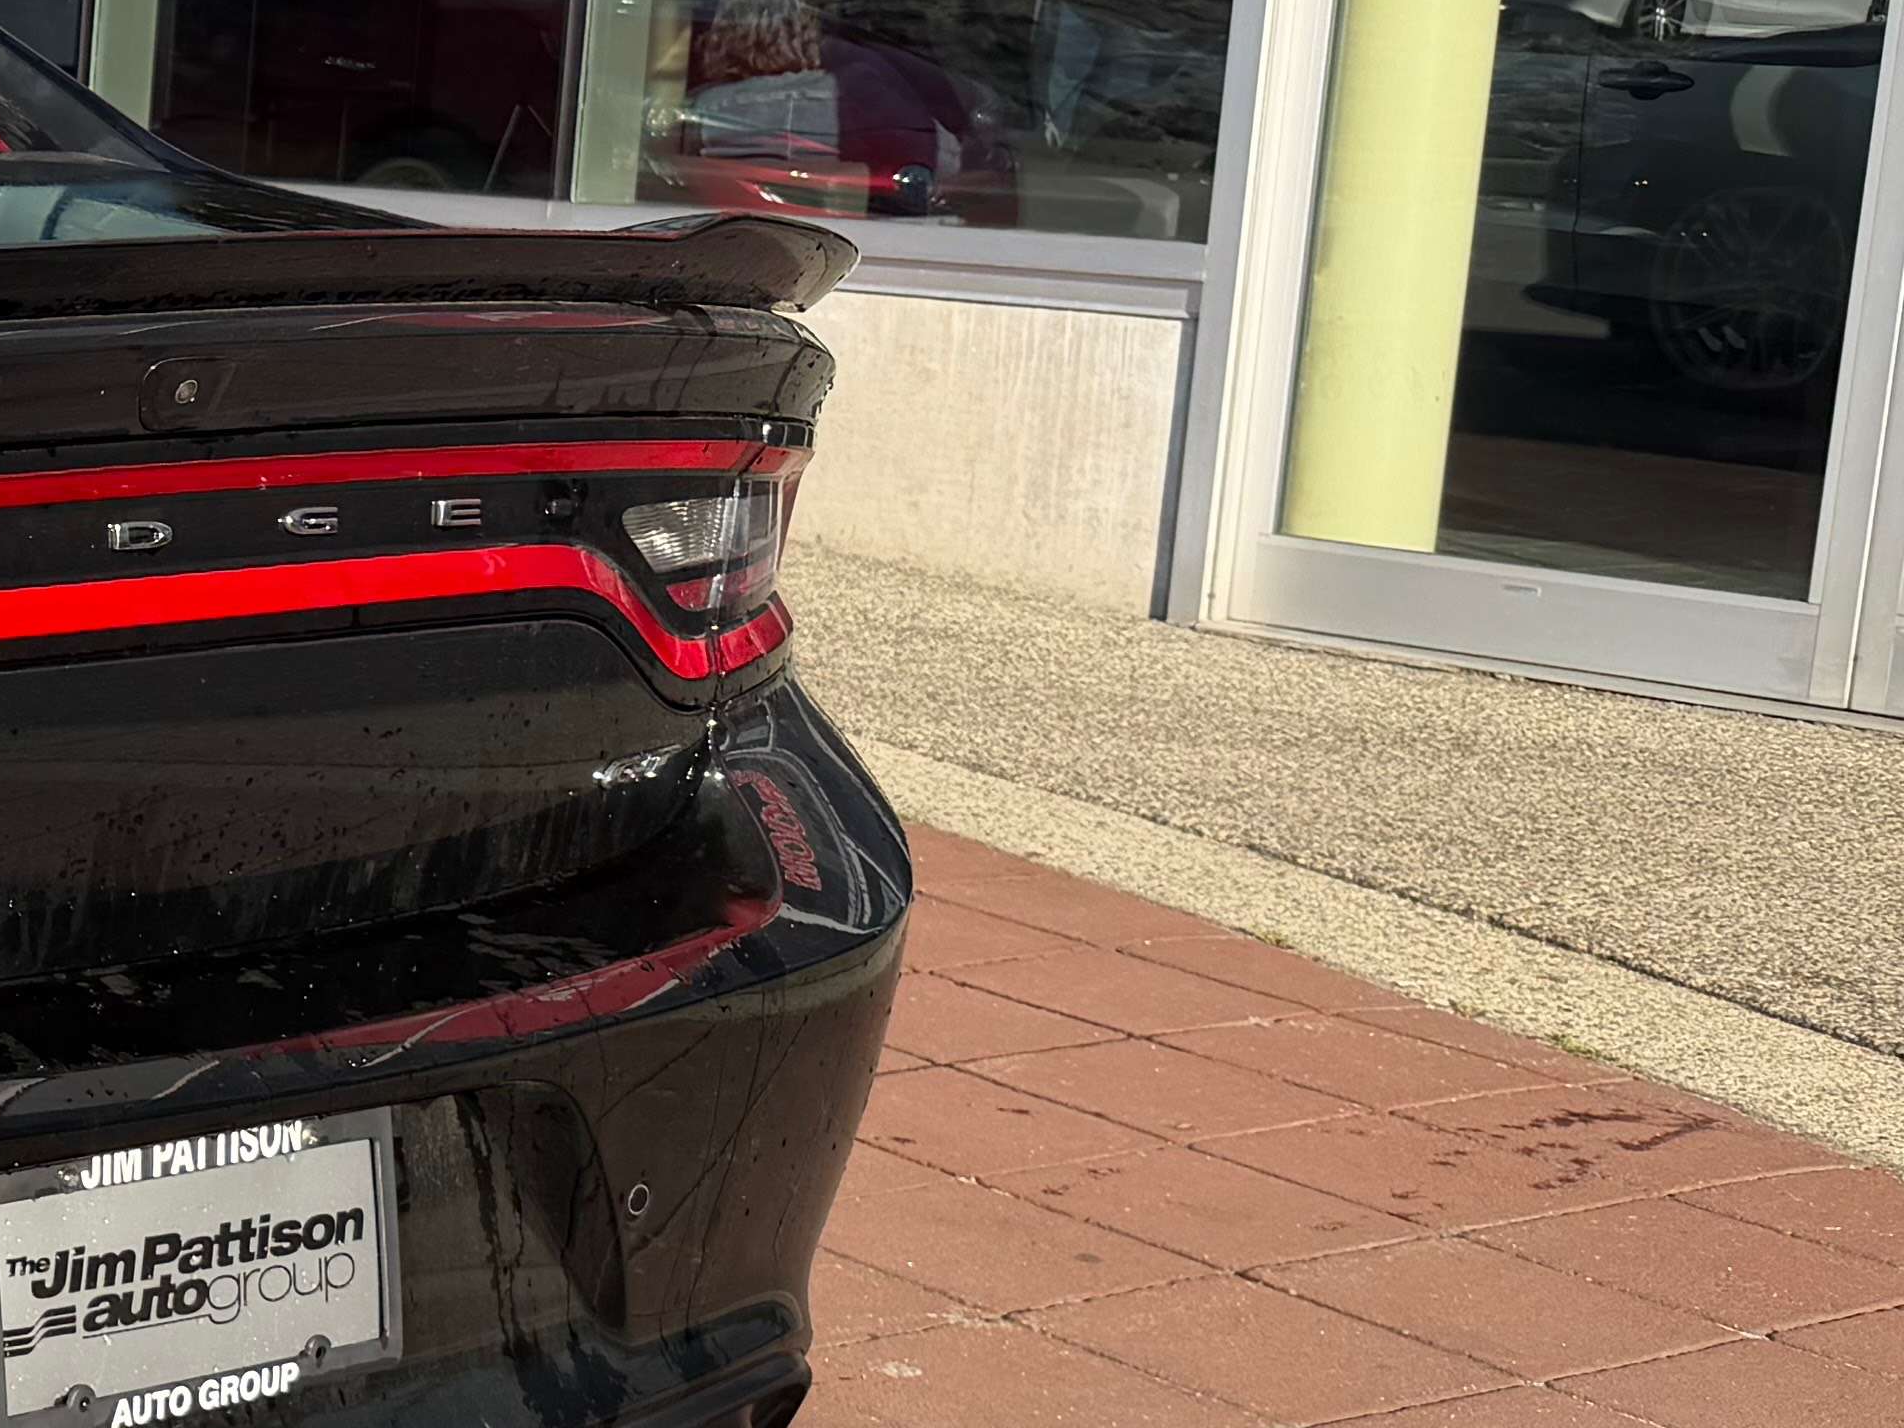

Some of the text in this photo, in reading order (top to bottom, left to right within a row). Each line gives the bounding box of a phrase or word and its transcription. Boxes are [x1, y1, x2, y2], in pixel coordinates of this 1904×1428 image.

[80, 1147, 142, 1189] JIM
[6, 1256, 51, 1278] The
[197, 1361, 300, 1411] GROUP
